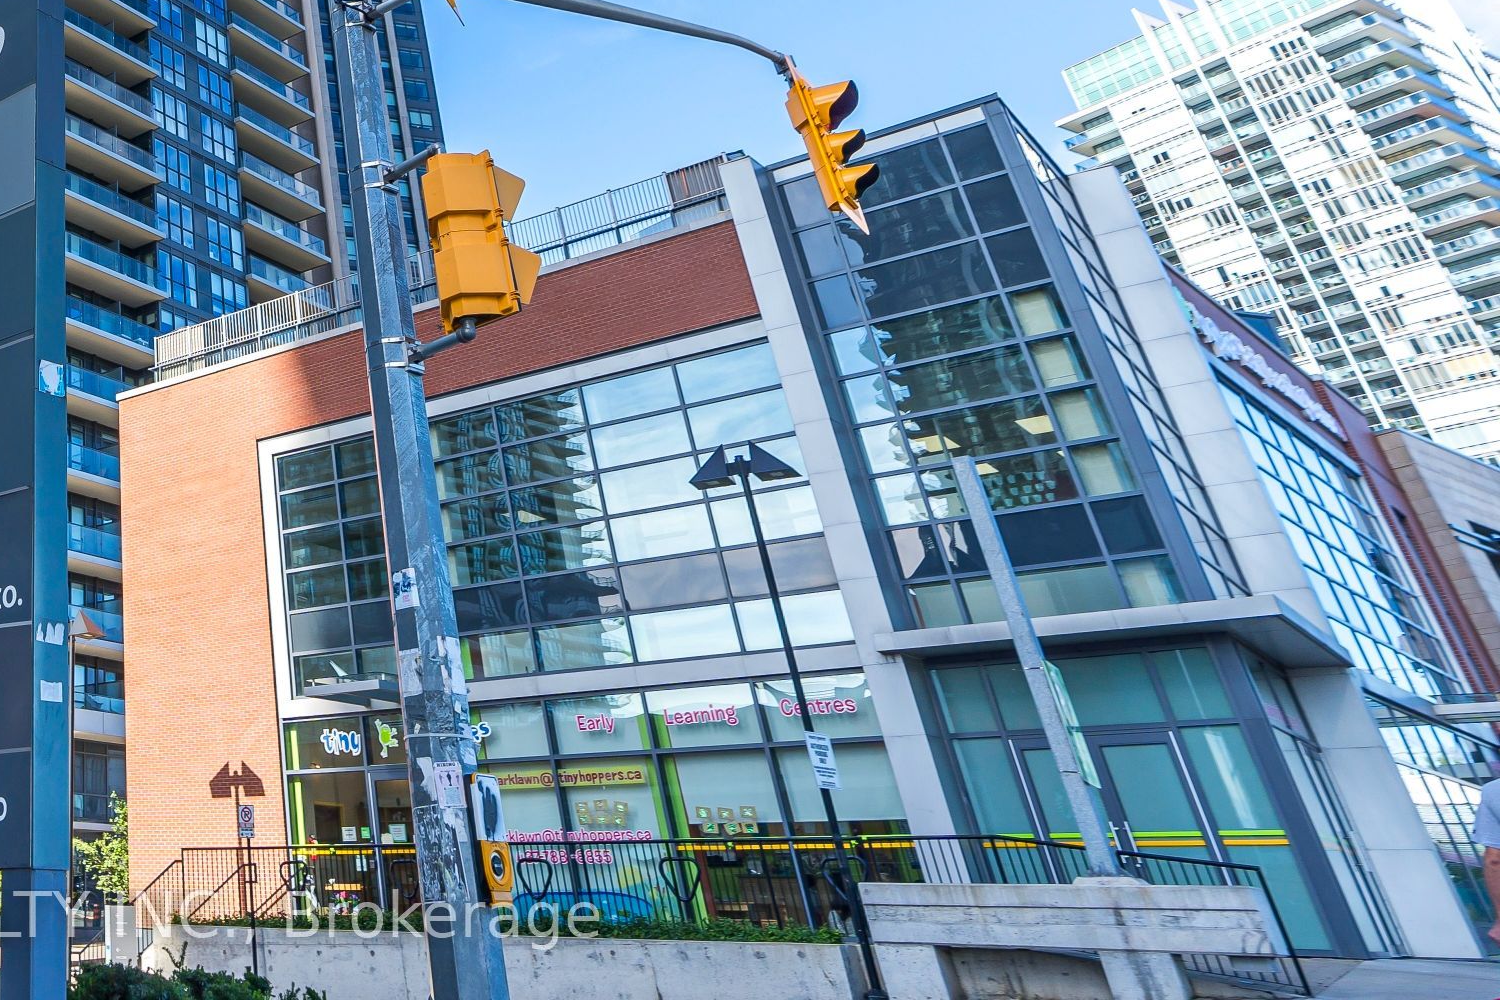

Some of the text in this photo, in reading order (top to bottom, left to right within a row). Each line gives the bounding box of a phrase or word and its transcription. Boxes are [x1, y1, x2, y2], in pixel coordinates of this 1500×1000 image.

[576, 698, 857, 733] Early Learning Centres
[321, 729, 361, 756] tiny
